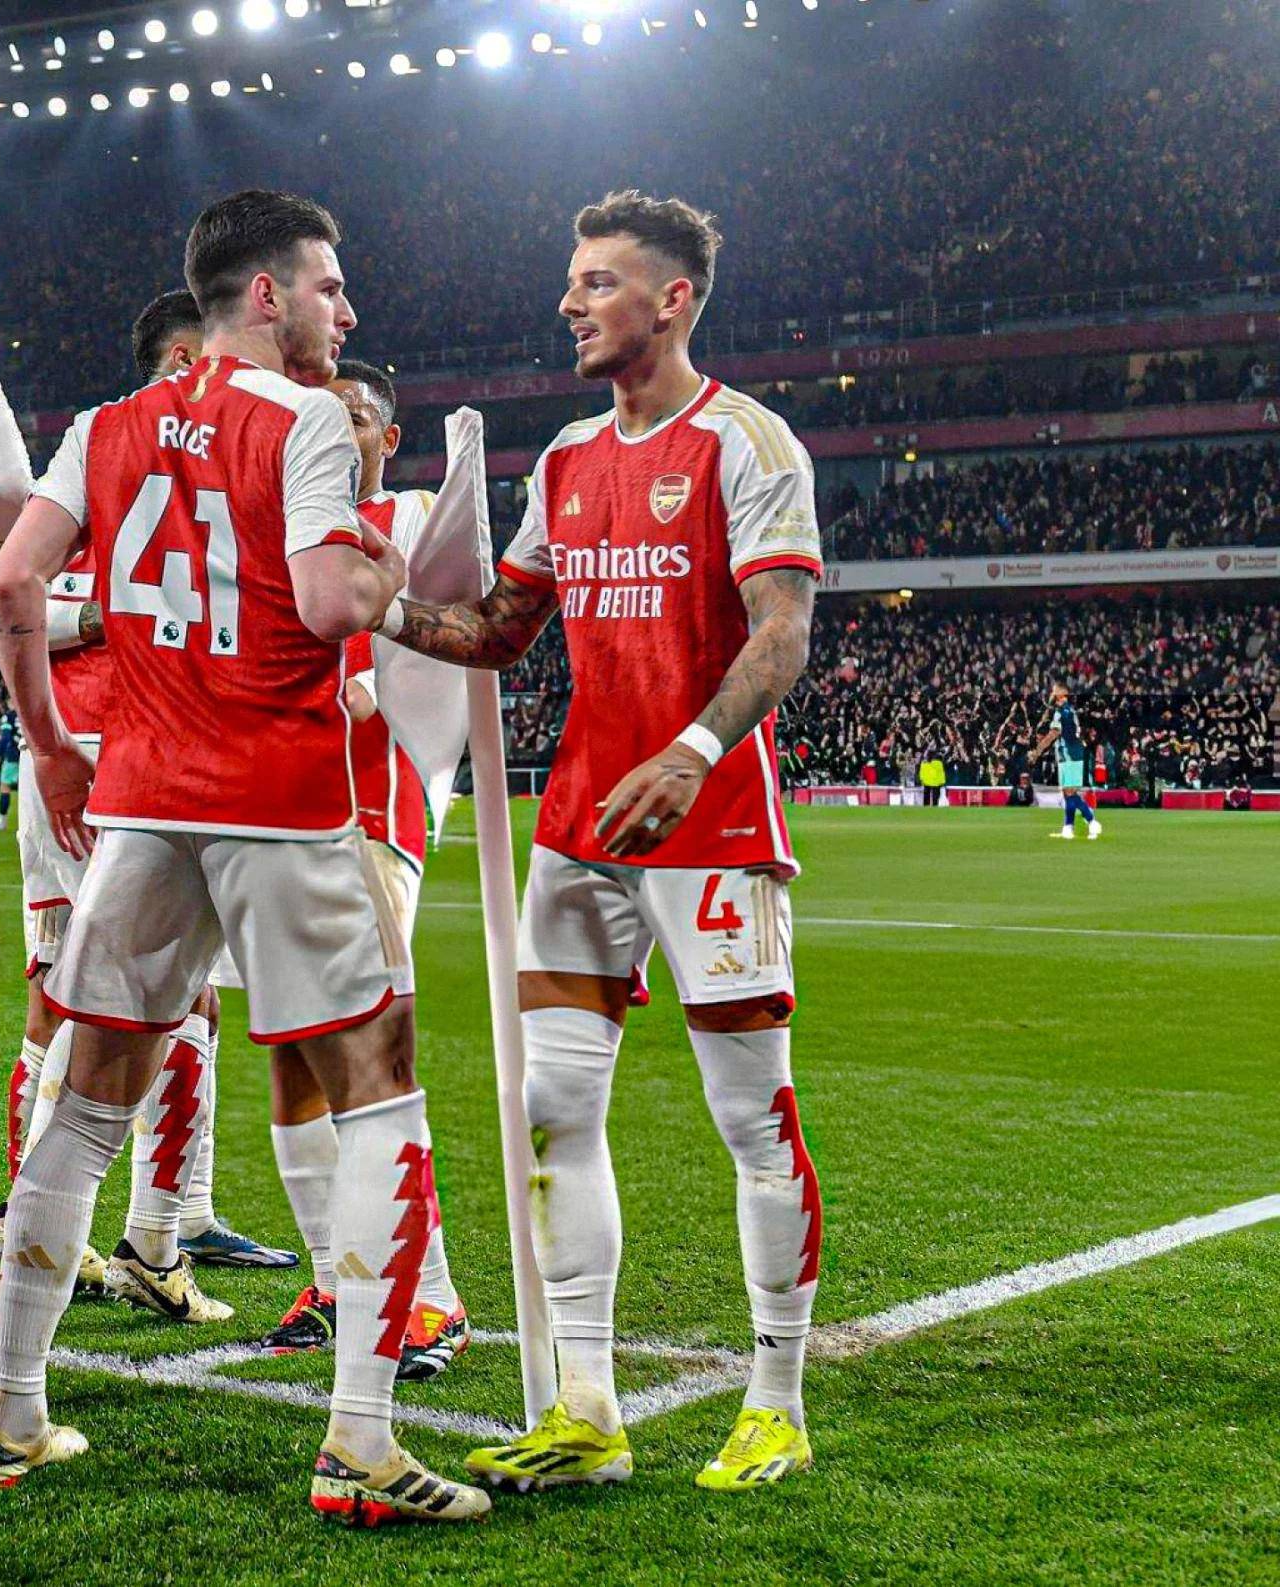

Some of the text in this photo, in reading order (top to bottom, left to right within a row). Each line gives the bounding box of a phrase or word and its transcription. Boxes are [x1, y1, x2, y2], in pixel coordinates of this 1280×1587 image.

[109, 473, 239, 656] 41
[549, 538, 691, 582] Emirates
[563, 585, 663, 618] FLY BETTER
[696, 873, 744, 932] 4
